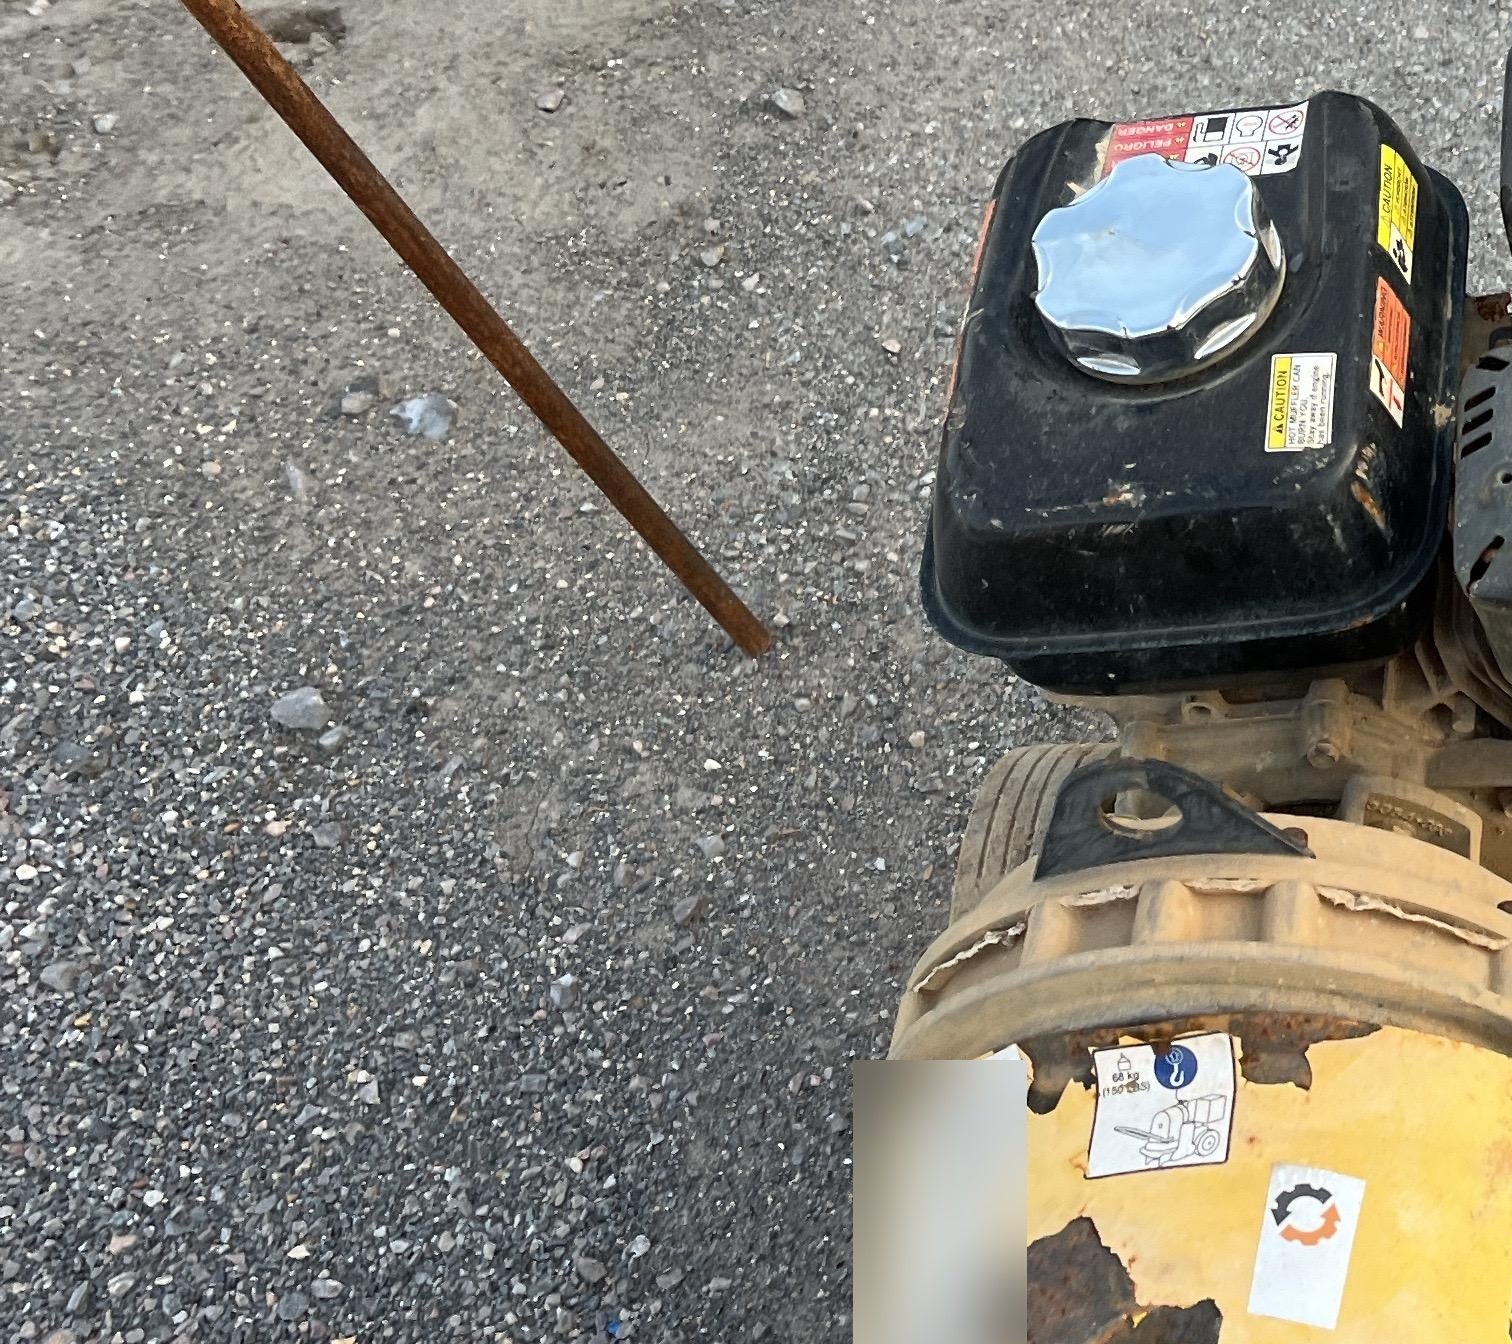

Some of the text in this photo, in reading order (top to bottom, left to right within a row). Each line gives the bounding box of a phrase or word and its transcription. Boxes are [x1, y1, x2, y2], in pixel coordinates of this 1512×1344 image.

[1117, 122, 1174, 136] DANGER
[1114, 138, 1172, 152] PELIGRO
[1382, 164, 1393, 214] CAUTION
[1312, 365, 1320, 392] engine
[1273, 370, 1288, 422] CAUTION
[1288, 364, 1301, 445] HOT MUFFLER CAN
[1297, 420, 1306, 445] BURN
[1112, 1071, 1140, 1083] 68 kg
[1102, 1085, 1124, 1098] (150
